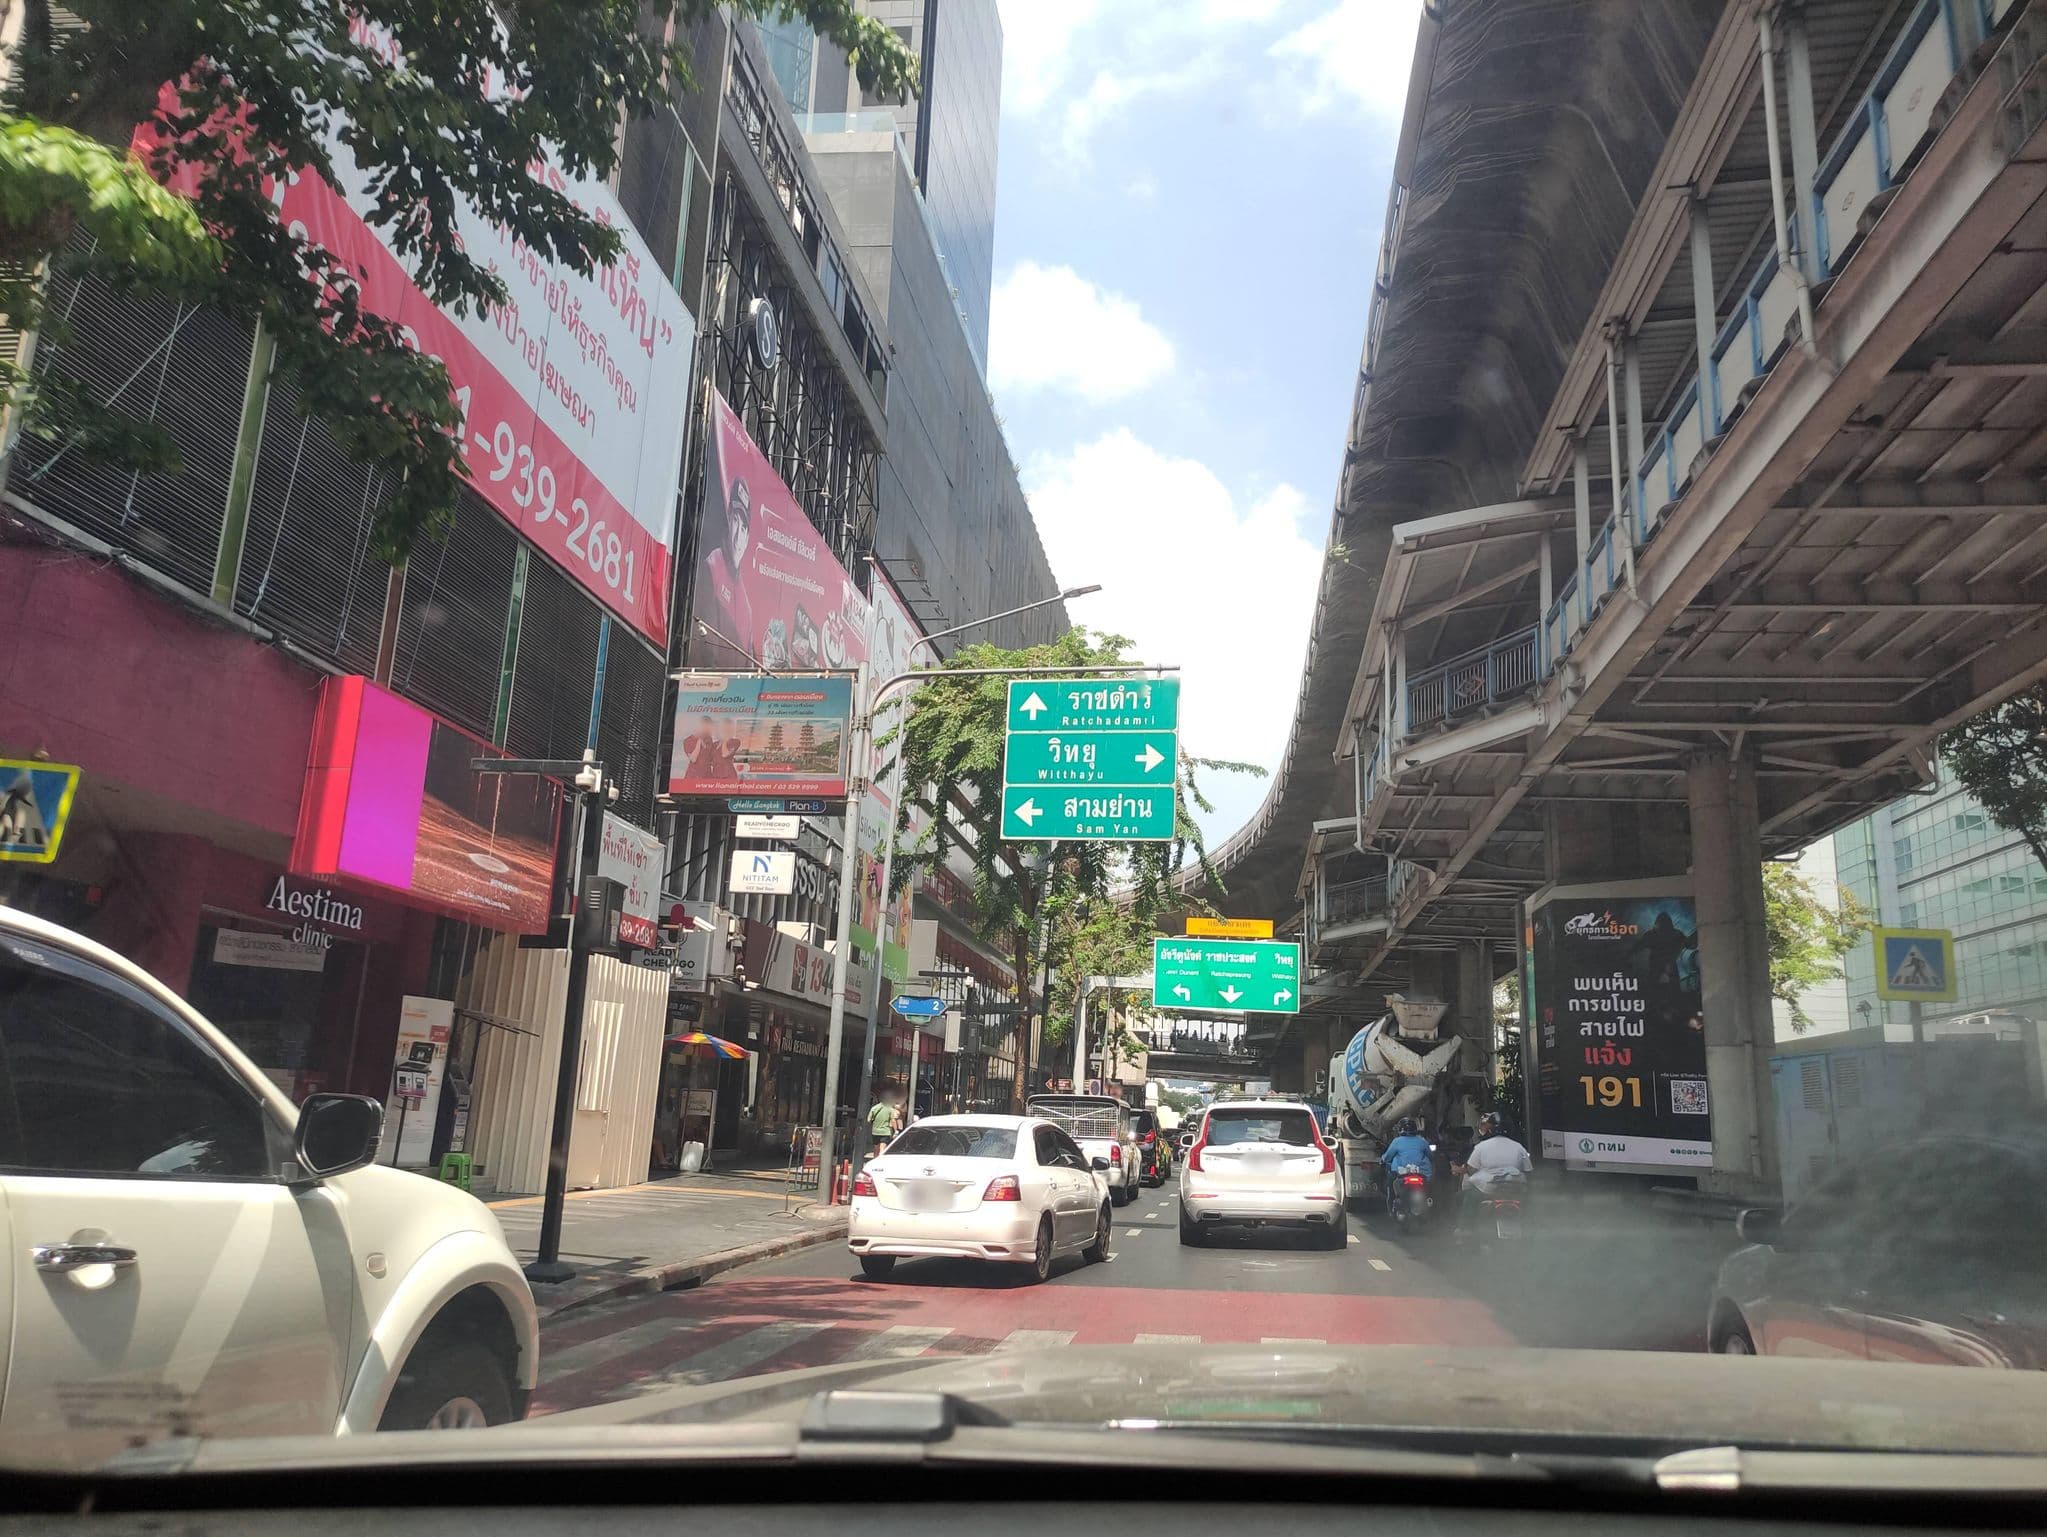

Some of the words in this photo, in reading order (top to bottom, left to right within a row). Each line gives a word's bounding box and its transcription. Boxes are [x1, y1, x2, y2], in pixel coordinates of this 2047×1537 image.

[1068, 685, 1152, 710] ราชดำริ
[1062, 715, 1155, 726] Ratchadamri
[1048, 737, 1097, 770] วิทยุ
[1038, 769, 1104, 781] Witthayu
[732, 800, 754, 809] Hello
[1064, 793, 1153, 818] สามย่าน
[1076, 824, 1105, 834] Sam
[1113, 824, 1139, 834] Yan
[603, 823, 648, 871] พื้นที่ให้เช่า
[742, 875, 779, 883] NITITAM
[629, 874, 640, 908] ชั้น
[643, 890, 648, 909] 7
[266, 875, 363, 930] Aestima
[292, 922, 333, 949] clinic
[620, 920, 655, 944] 39-2681
[643, 958, 695, 969] CHECGO
[1205, 951, 1258, 964] ราชประสงค์
[1274, 953, 1294, 969] วิทยุ
[1574, 972, 1638, 992] พบเห็น
[932, 1001, 940, 1010] 2
[1568, 993, 1646, 1012] การขโมย
[1579, 1016, 1645, 1037] สายไฟ
[1584, 1040, 1633, 1066] แจ้ง
[1579, 1076, 1641, 1107] 191
[1598, 1142, 1626, 1153] กทม
